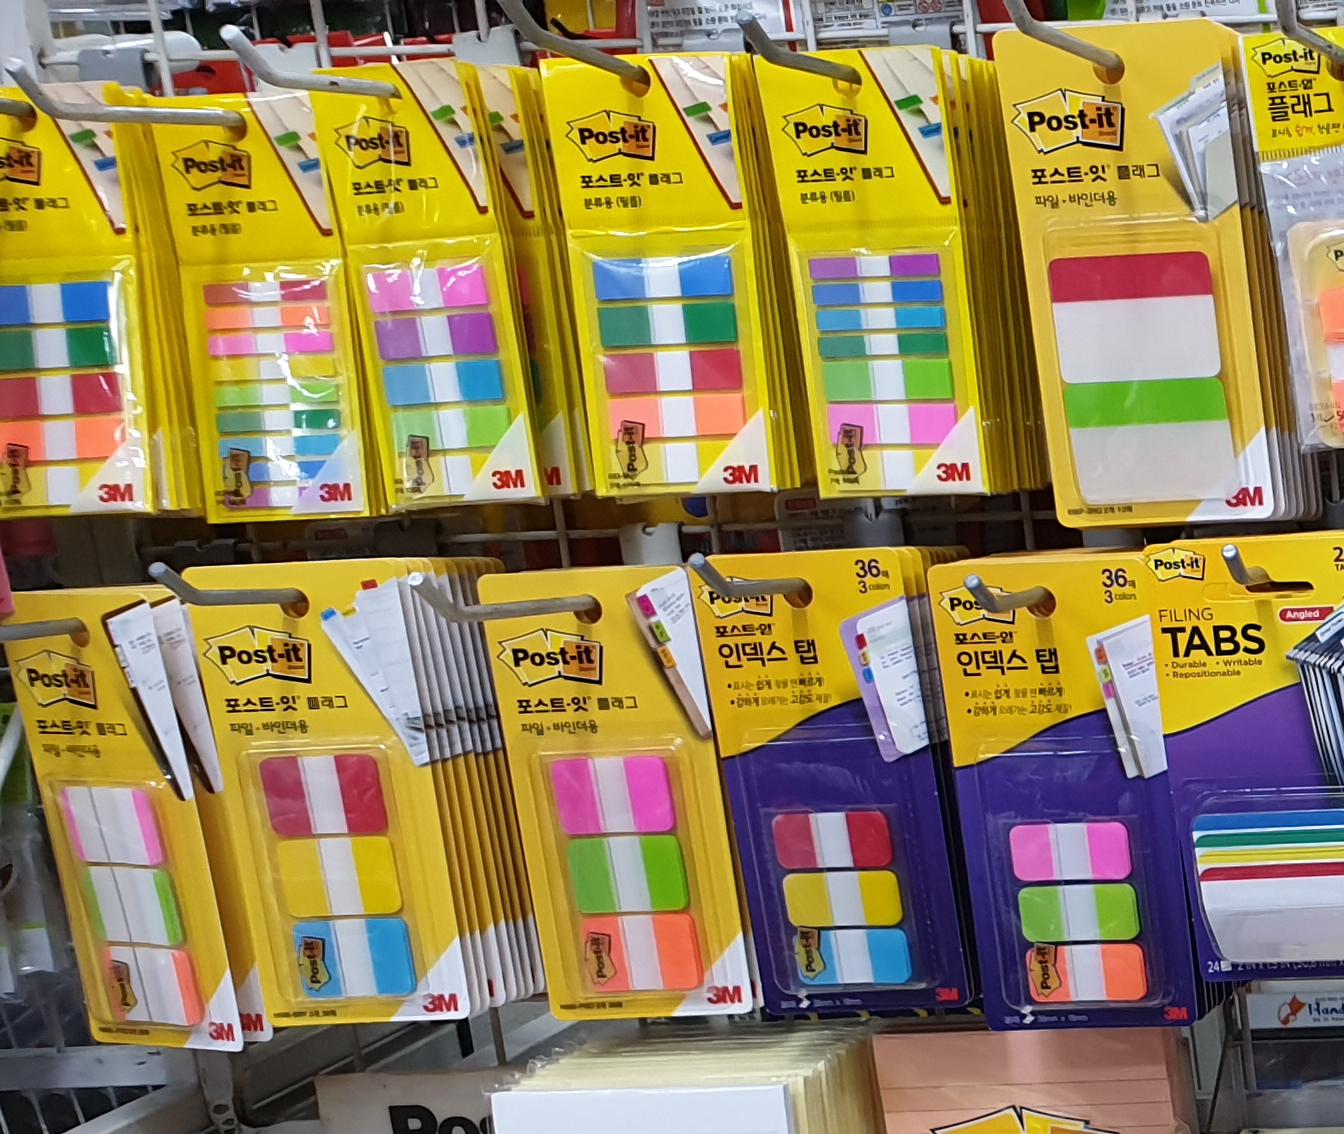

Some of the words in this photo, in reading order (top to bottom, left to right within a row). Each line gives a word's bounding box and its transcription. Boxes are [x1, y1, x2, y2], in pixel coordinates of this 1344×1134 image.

[1268, 92, 1335, 122] 플래그
[1034, 194, 1060, 206] 파일
[1068, 191, 1117, 206] 바인더용
[859, 581, 867, 593] 3
[1159, 608, 1213, 622] FILING
[1286, 608, 1319, 620] Angled
[1161, 625, 1265, 658] TABS
[218, 645, 304, 666] Post-it
[719, 644, 787, 669] 인덱스
[794, 639, 818, 665] 탭
[1171, 659, 1208, 668] Durable
[1223, 657, 1262, 666] Writable
[1172, 668, 1241, 678] Repositionable
[423, 994, 458, 1012] 3M
